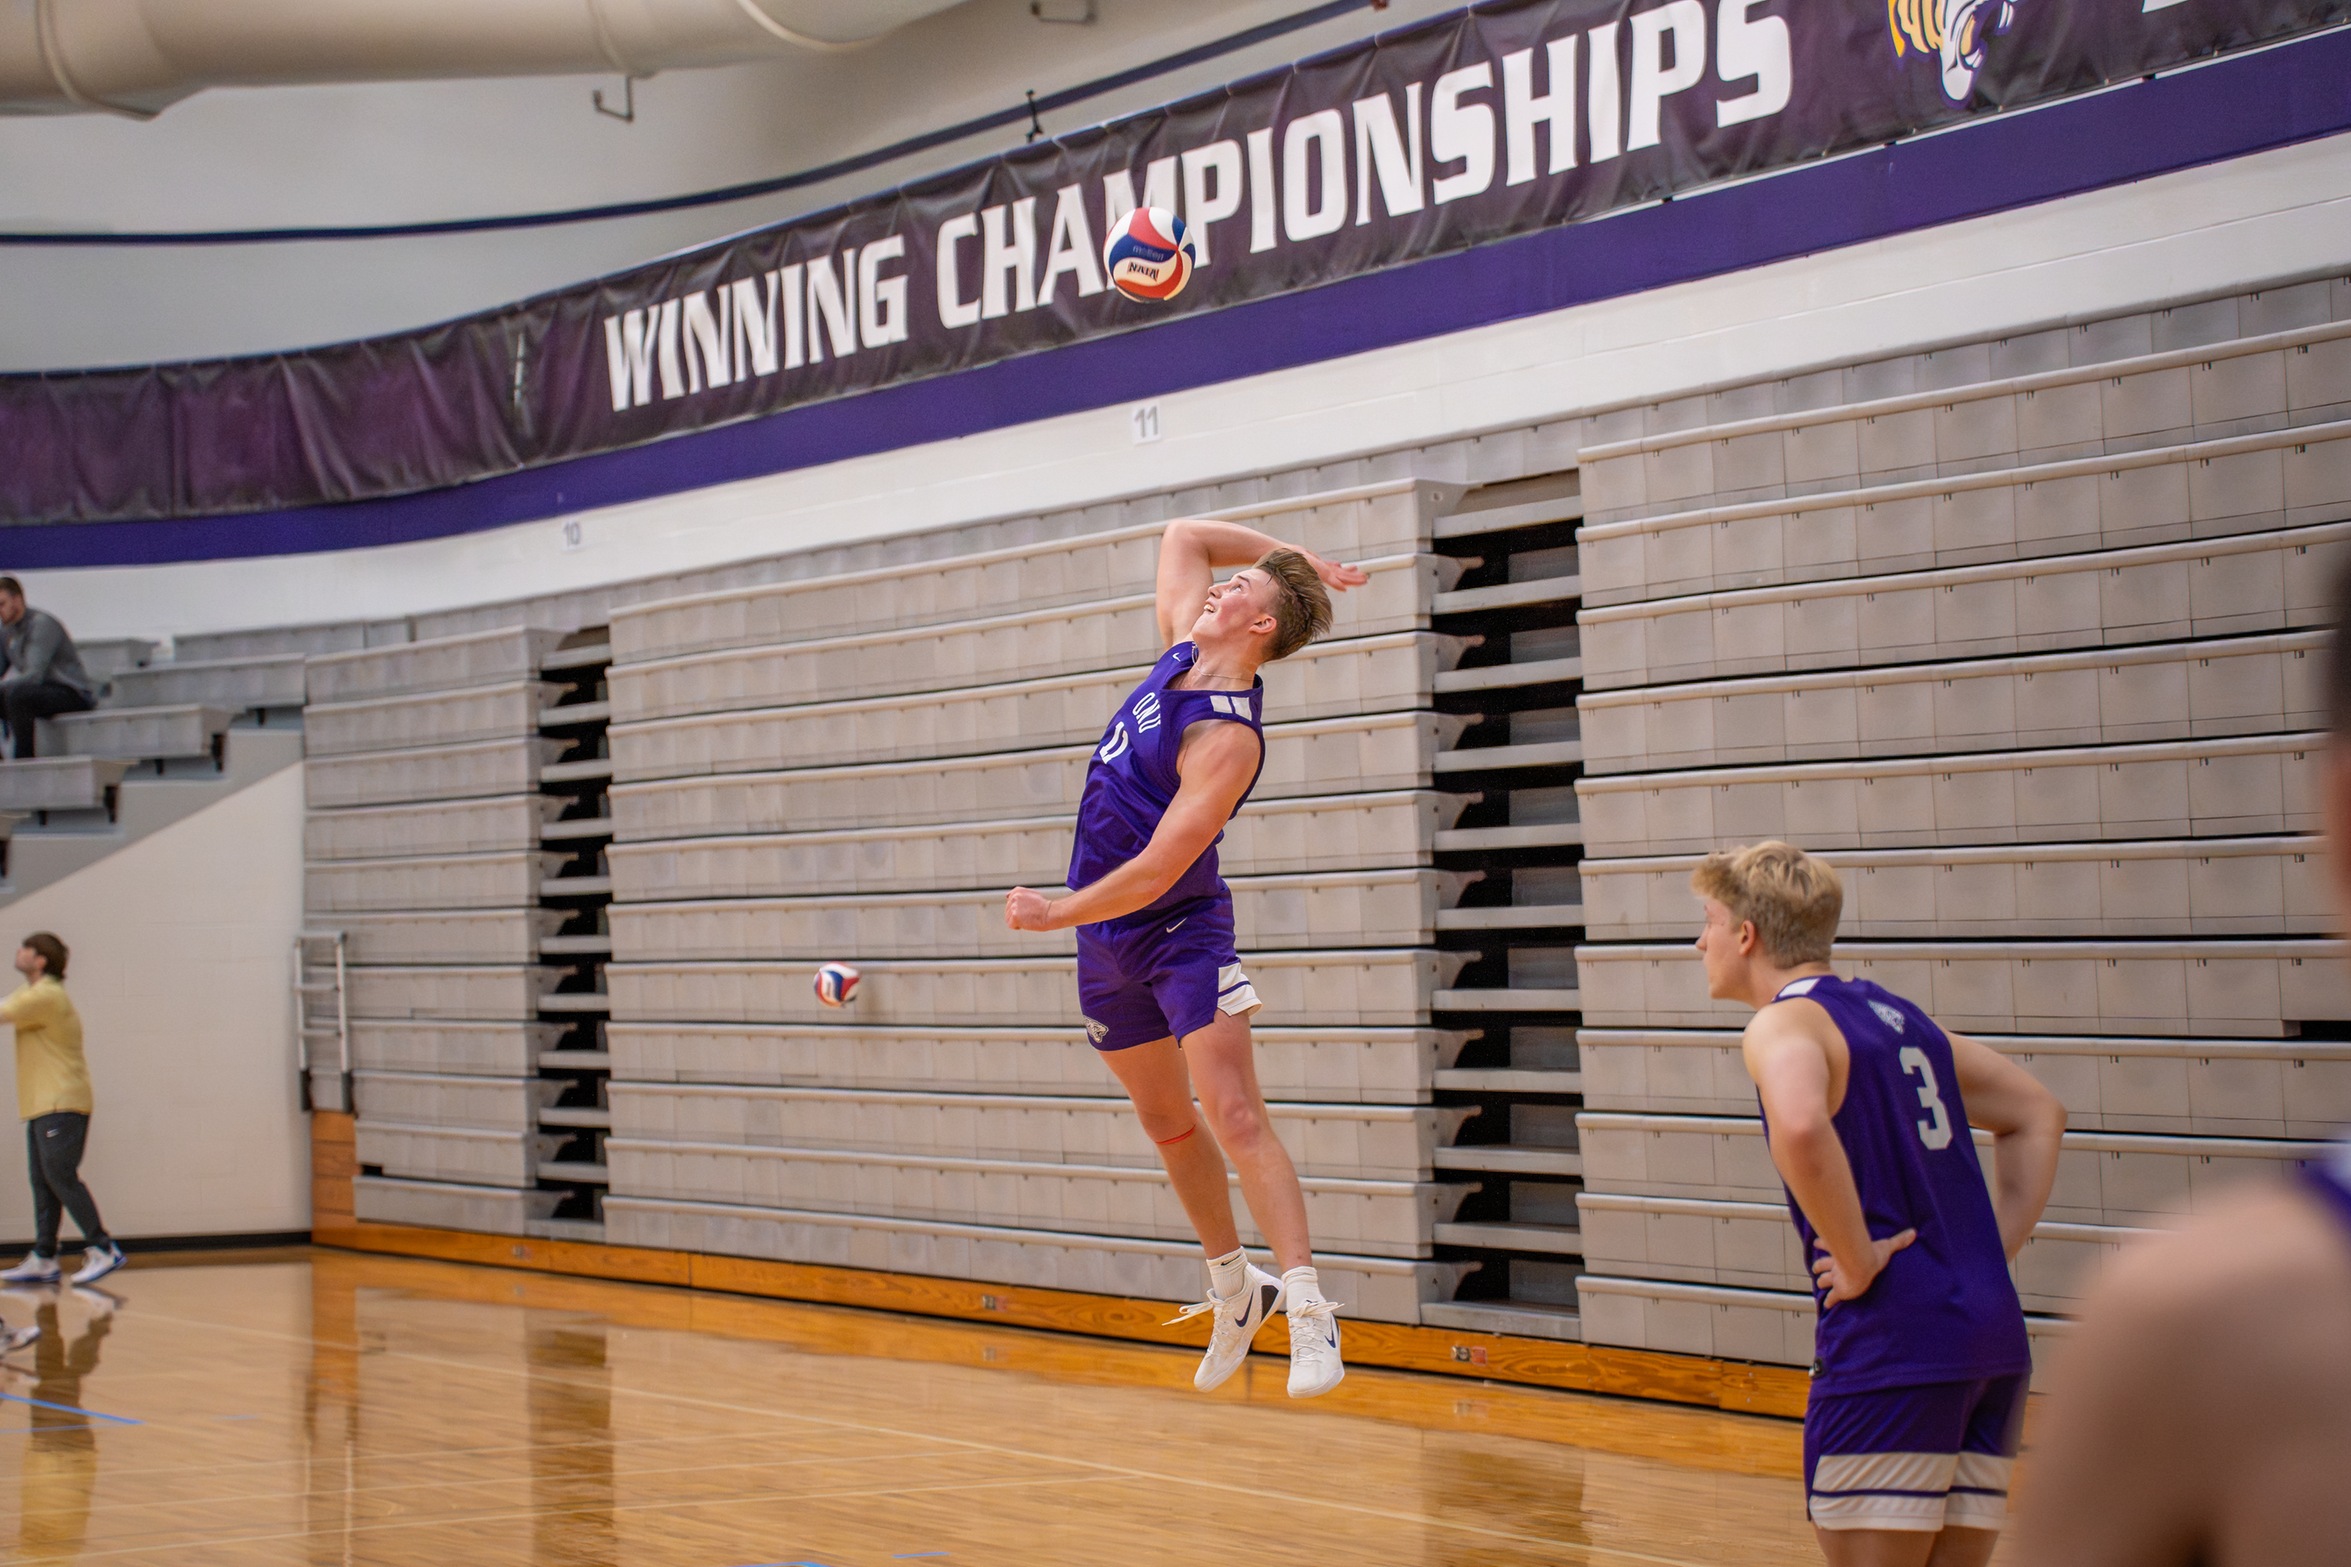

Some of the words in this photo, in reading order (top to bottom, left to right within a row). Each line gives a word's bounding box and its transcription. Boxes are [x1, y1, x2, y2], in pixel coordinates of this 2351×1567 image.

[1127, 261, 1159, 282] NAIA
[604, 234, 908, 412] WINNING
[1134, 405, 1159, 438] 11
[562, 521, 582, 547] 10
[1132, 692, 1161, 734] ONU
[1899, 1047, 1953, 1151] 3
